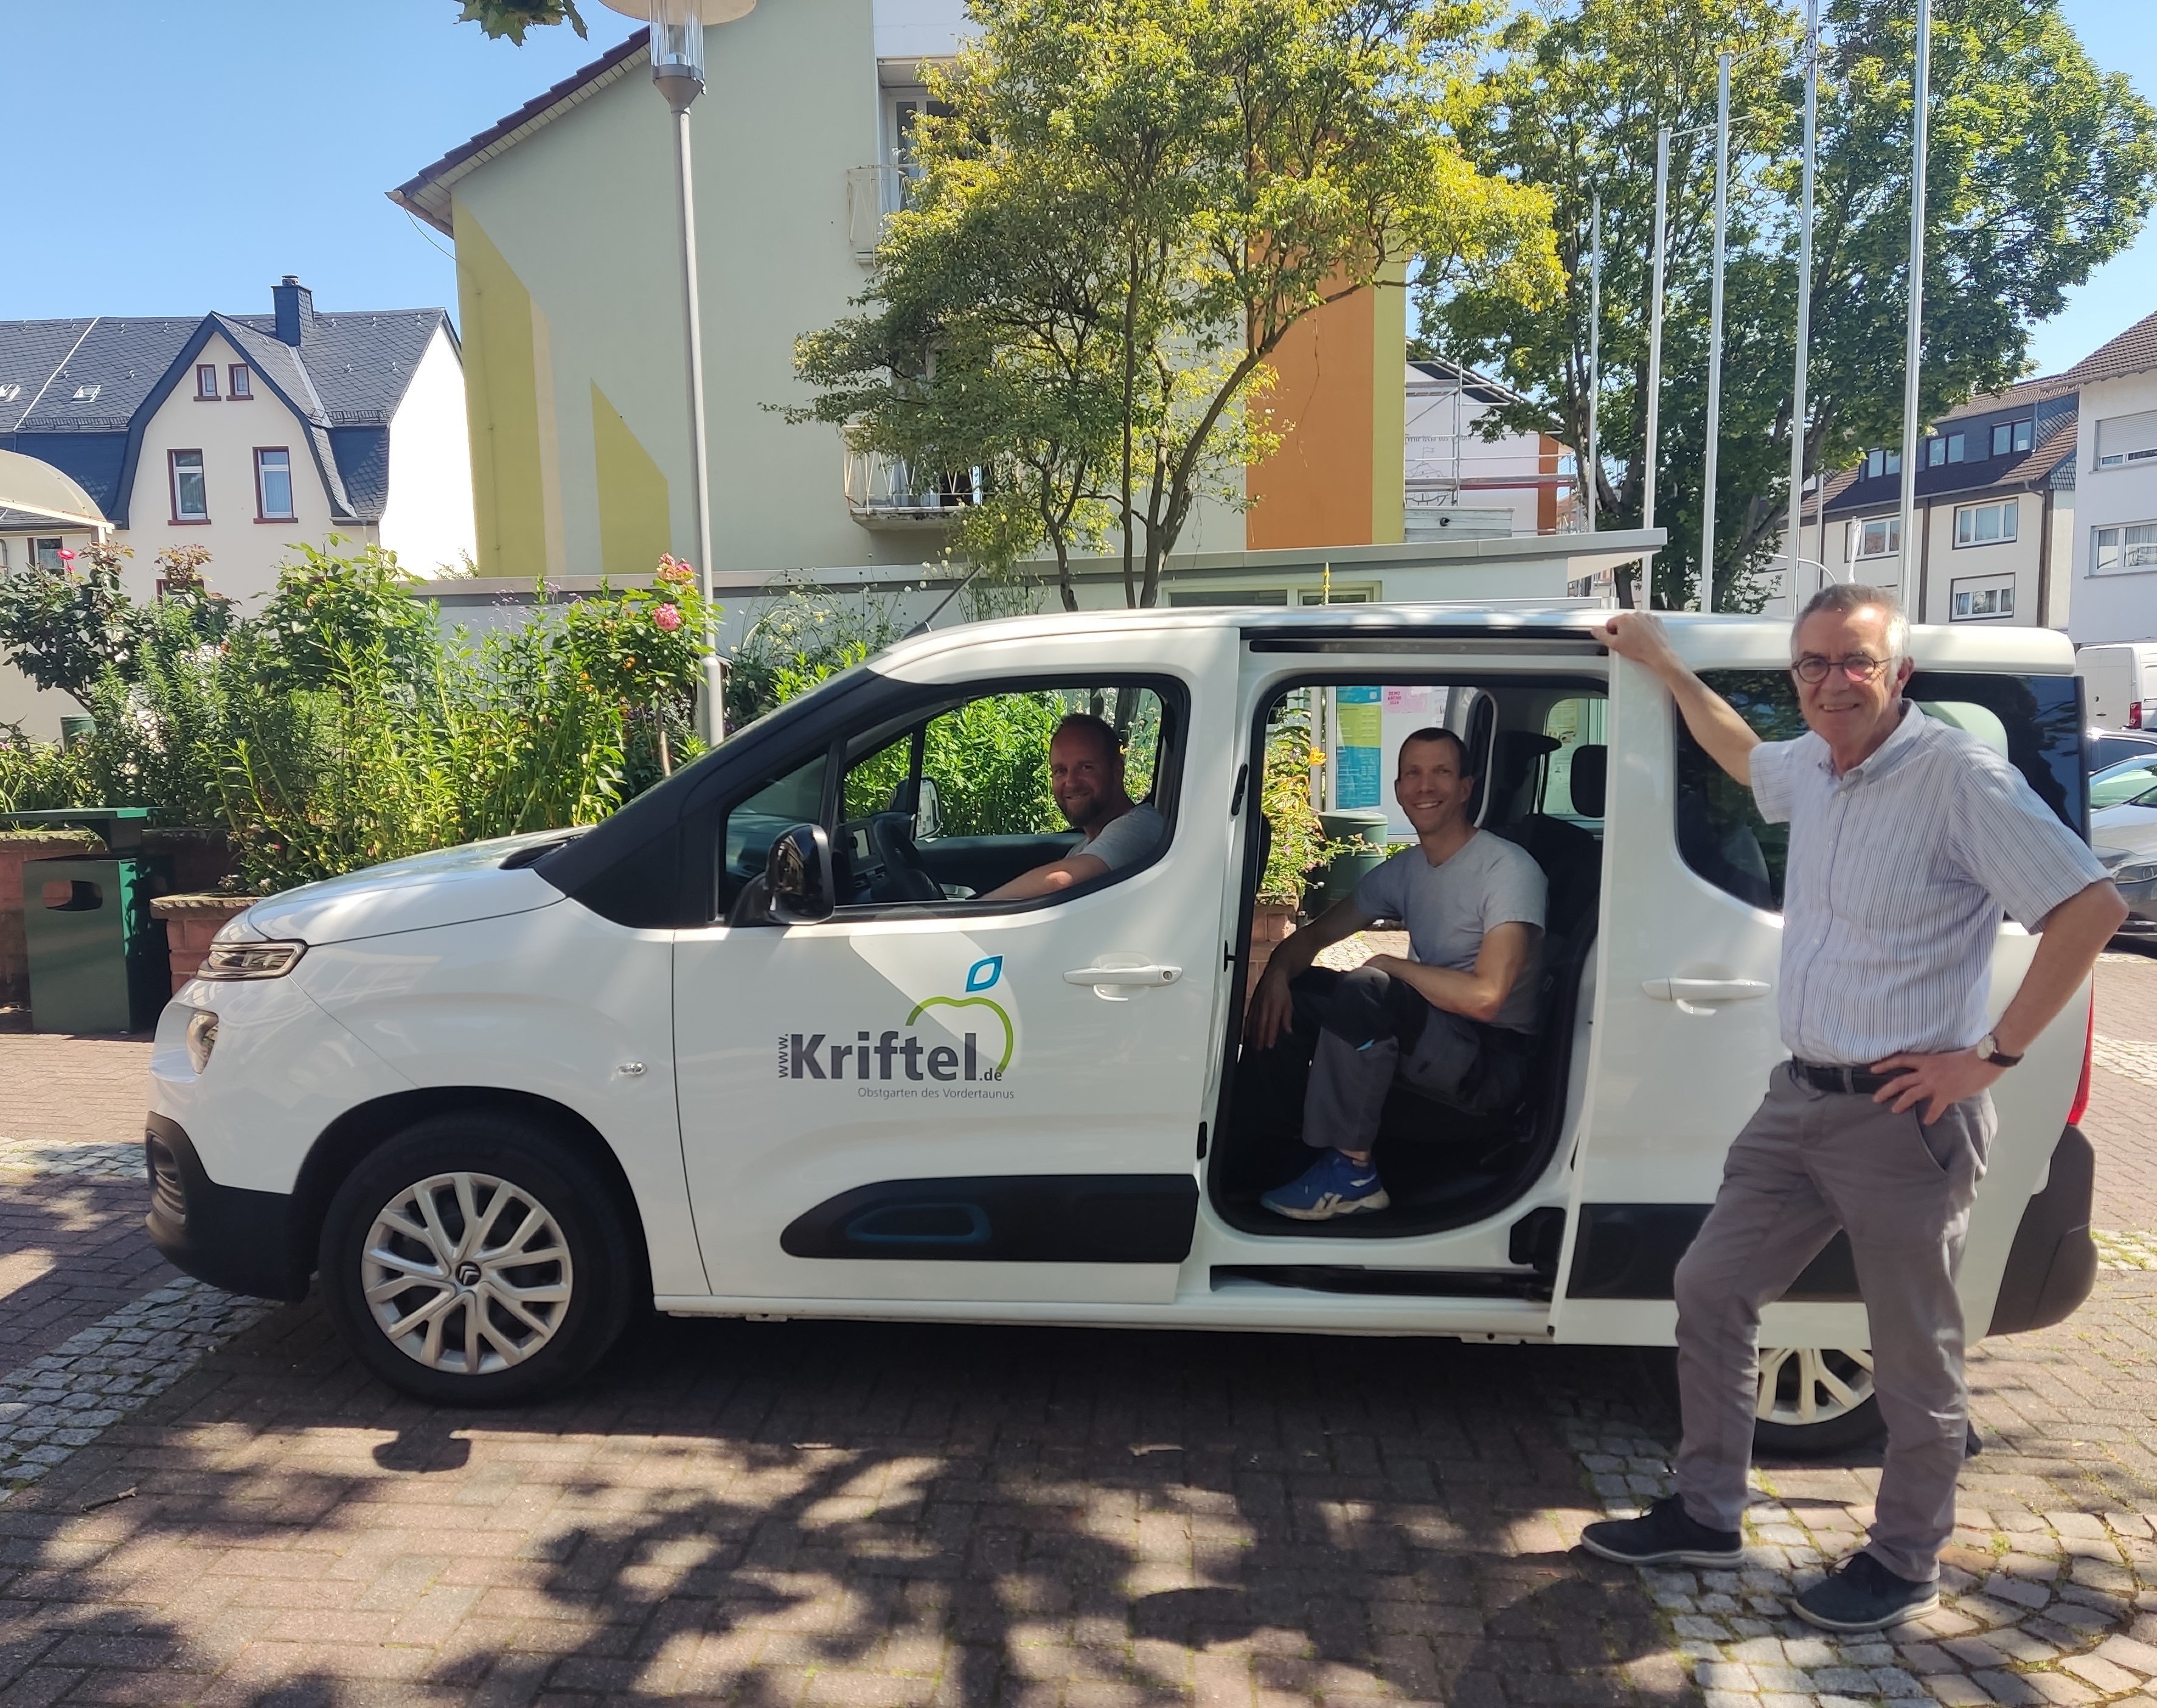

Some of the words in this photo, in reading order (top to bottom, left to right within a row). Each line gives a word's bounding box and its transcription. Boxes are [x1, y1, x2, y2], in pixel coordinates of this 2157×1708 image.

[778, 1033, 788, 1078] www.
[857, 1087, 917, 1100] Obstgarten
[921, 1088, 940, 1099] des
[942, 1088, 1015, 1099] Vordertaunus
